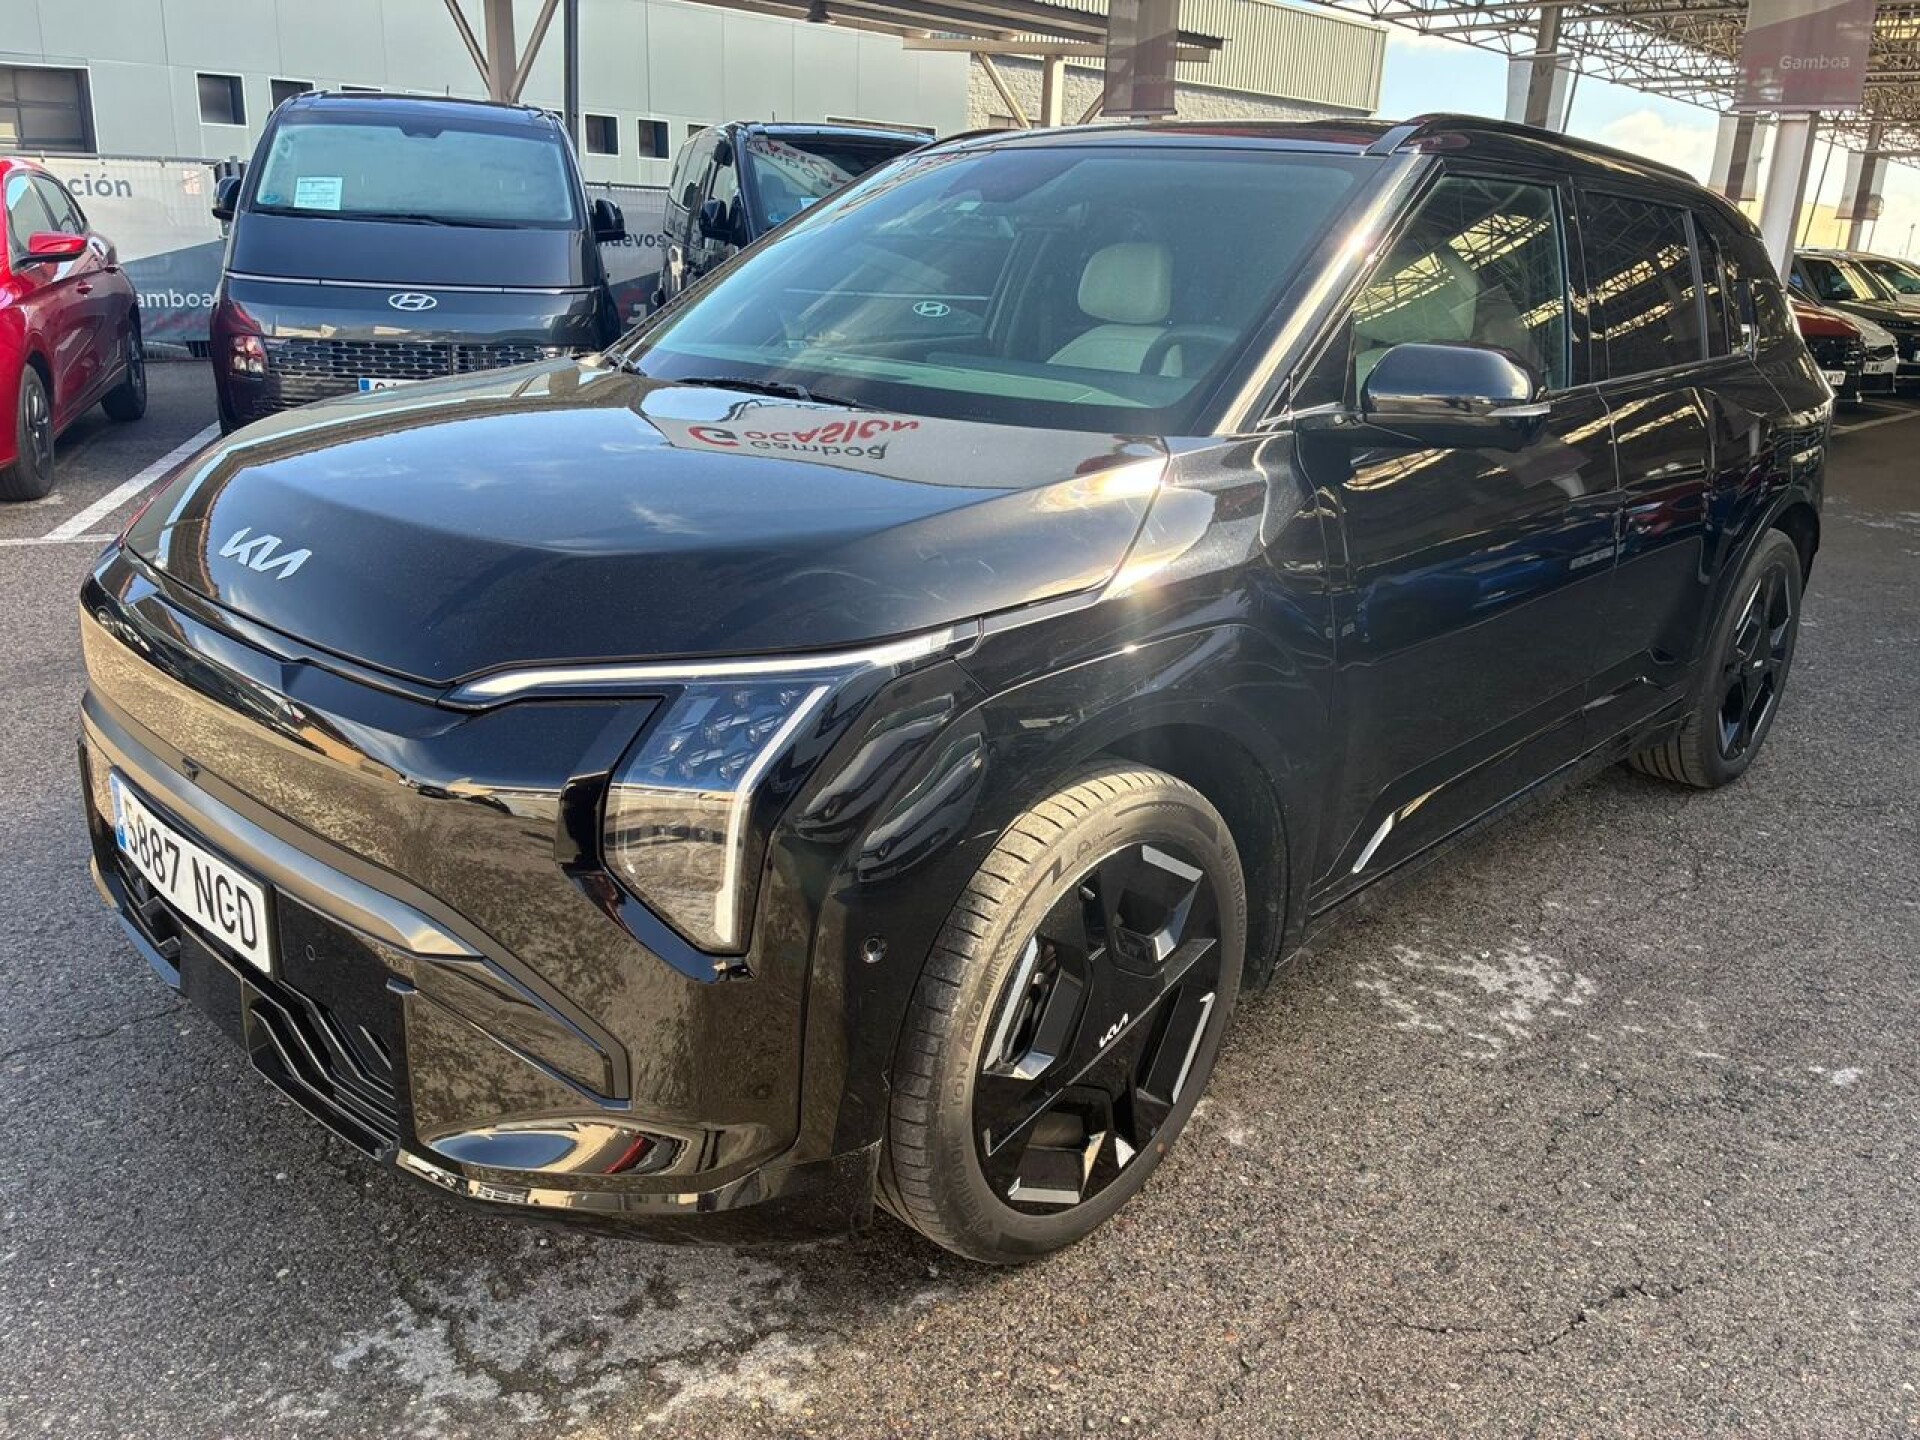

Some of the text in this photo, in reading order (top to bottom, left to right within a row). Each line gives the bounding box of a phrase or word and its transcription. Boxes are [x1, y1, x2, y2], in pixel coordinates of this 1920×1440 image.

[1779, 54, 1850, 70] Gamboa
[67, 172, 133, 198] ción
[137, 288, 214, 308] amboa
[219, 527, 313, 580] KIA
[125, 799, 258, 951] 5887 NGD
